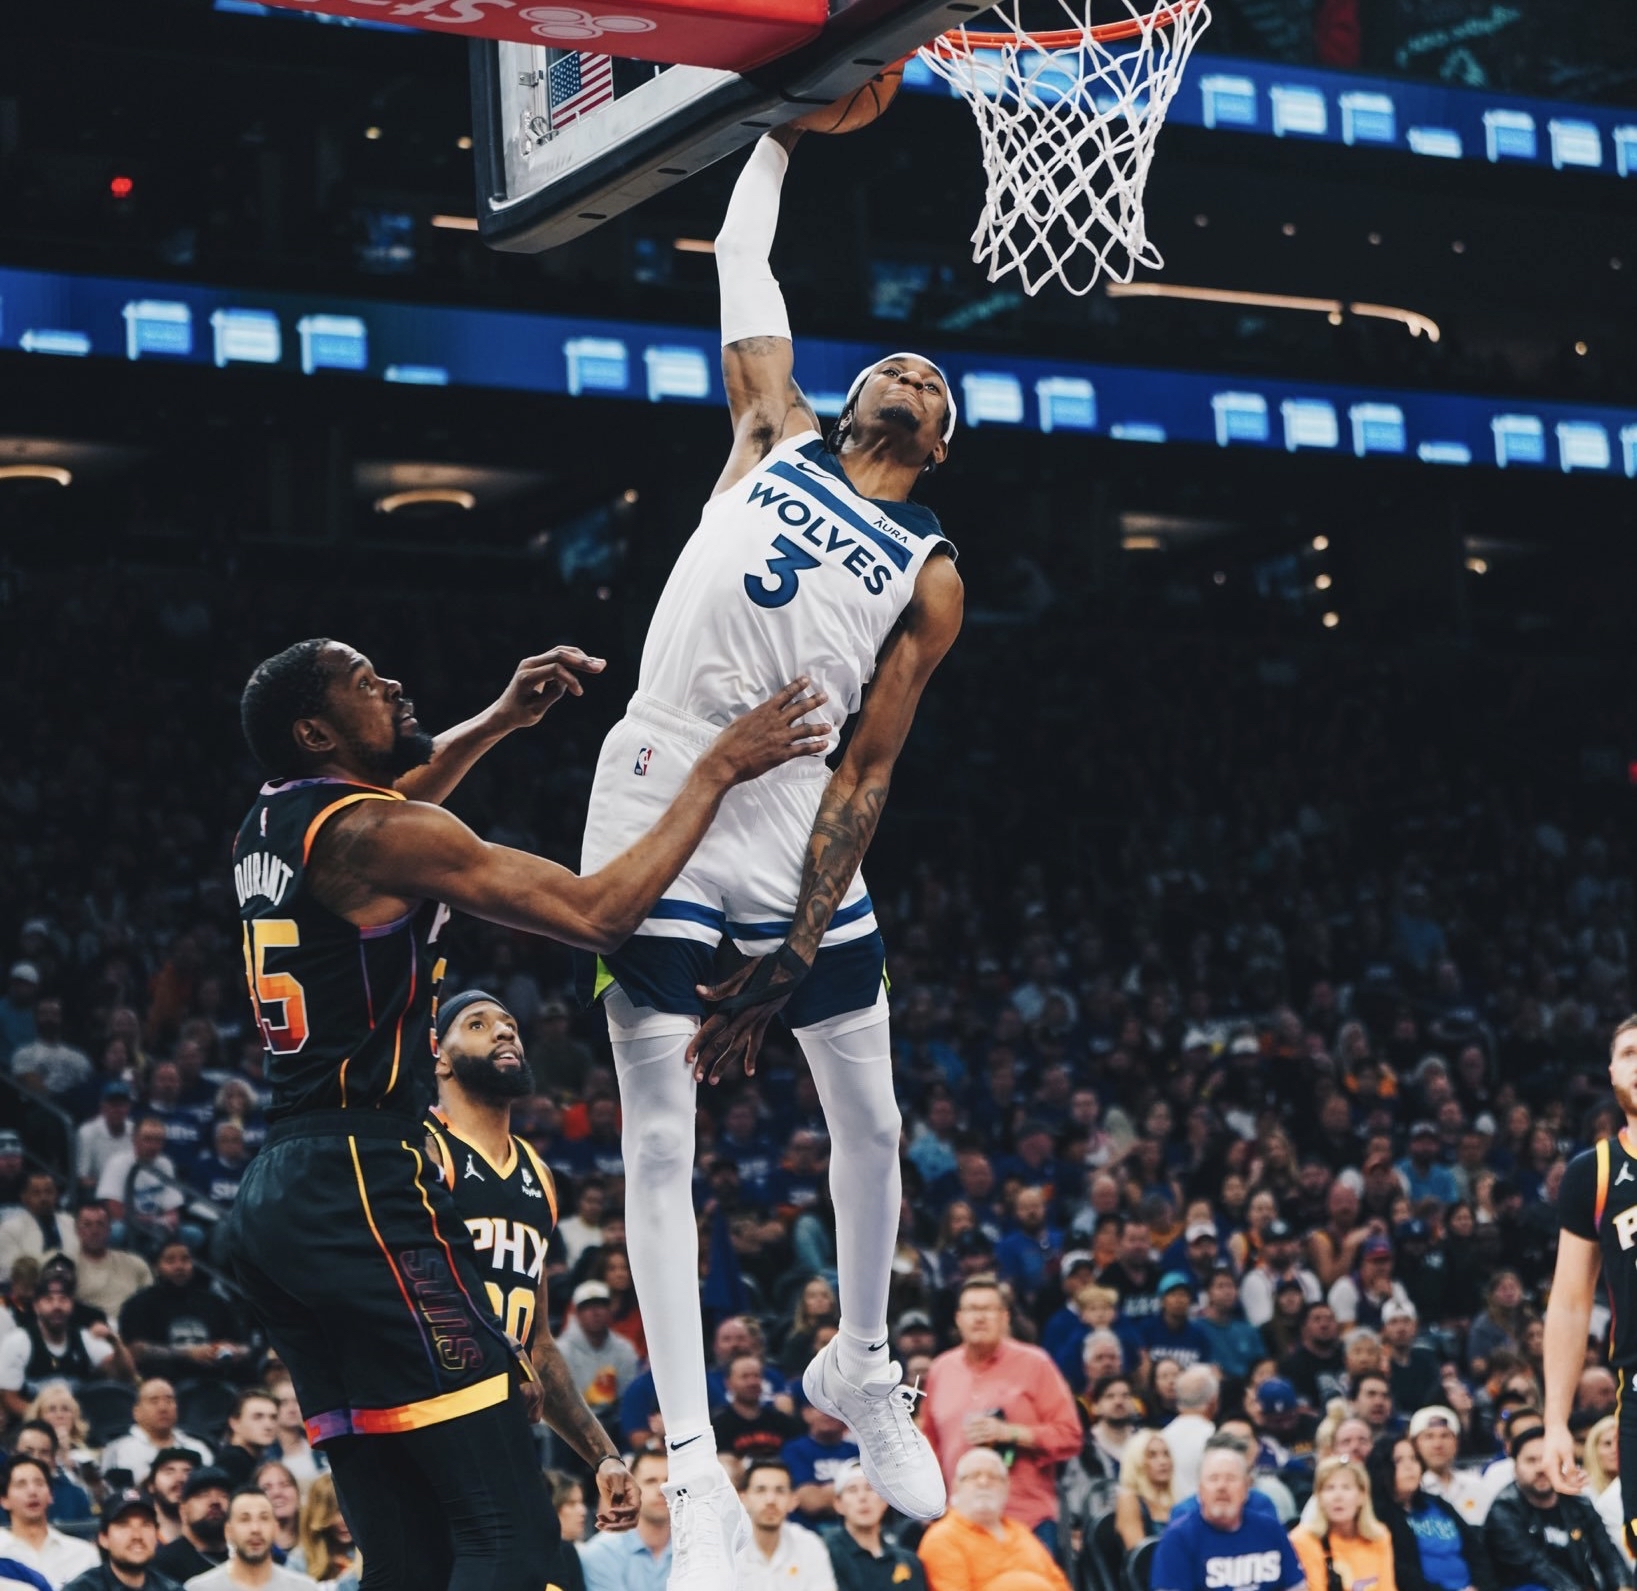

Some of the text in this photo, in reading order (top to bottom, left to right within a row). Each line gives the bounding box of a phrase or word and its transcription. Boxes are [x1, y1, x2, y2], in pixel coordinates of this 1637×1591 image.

[743, 533, 822, 609] 3
[746, 481, 893, 596] WOLVES
[234, 851, 294, 908] DURANT
[242, 918, 310, 1056] 5
[463, 1217, 549, 1285] PHX
